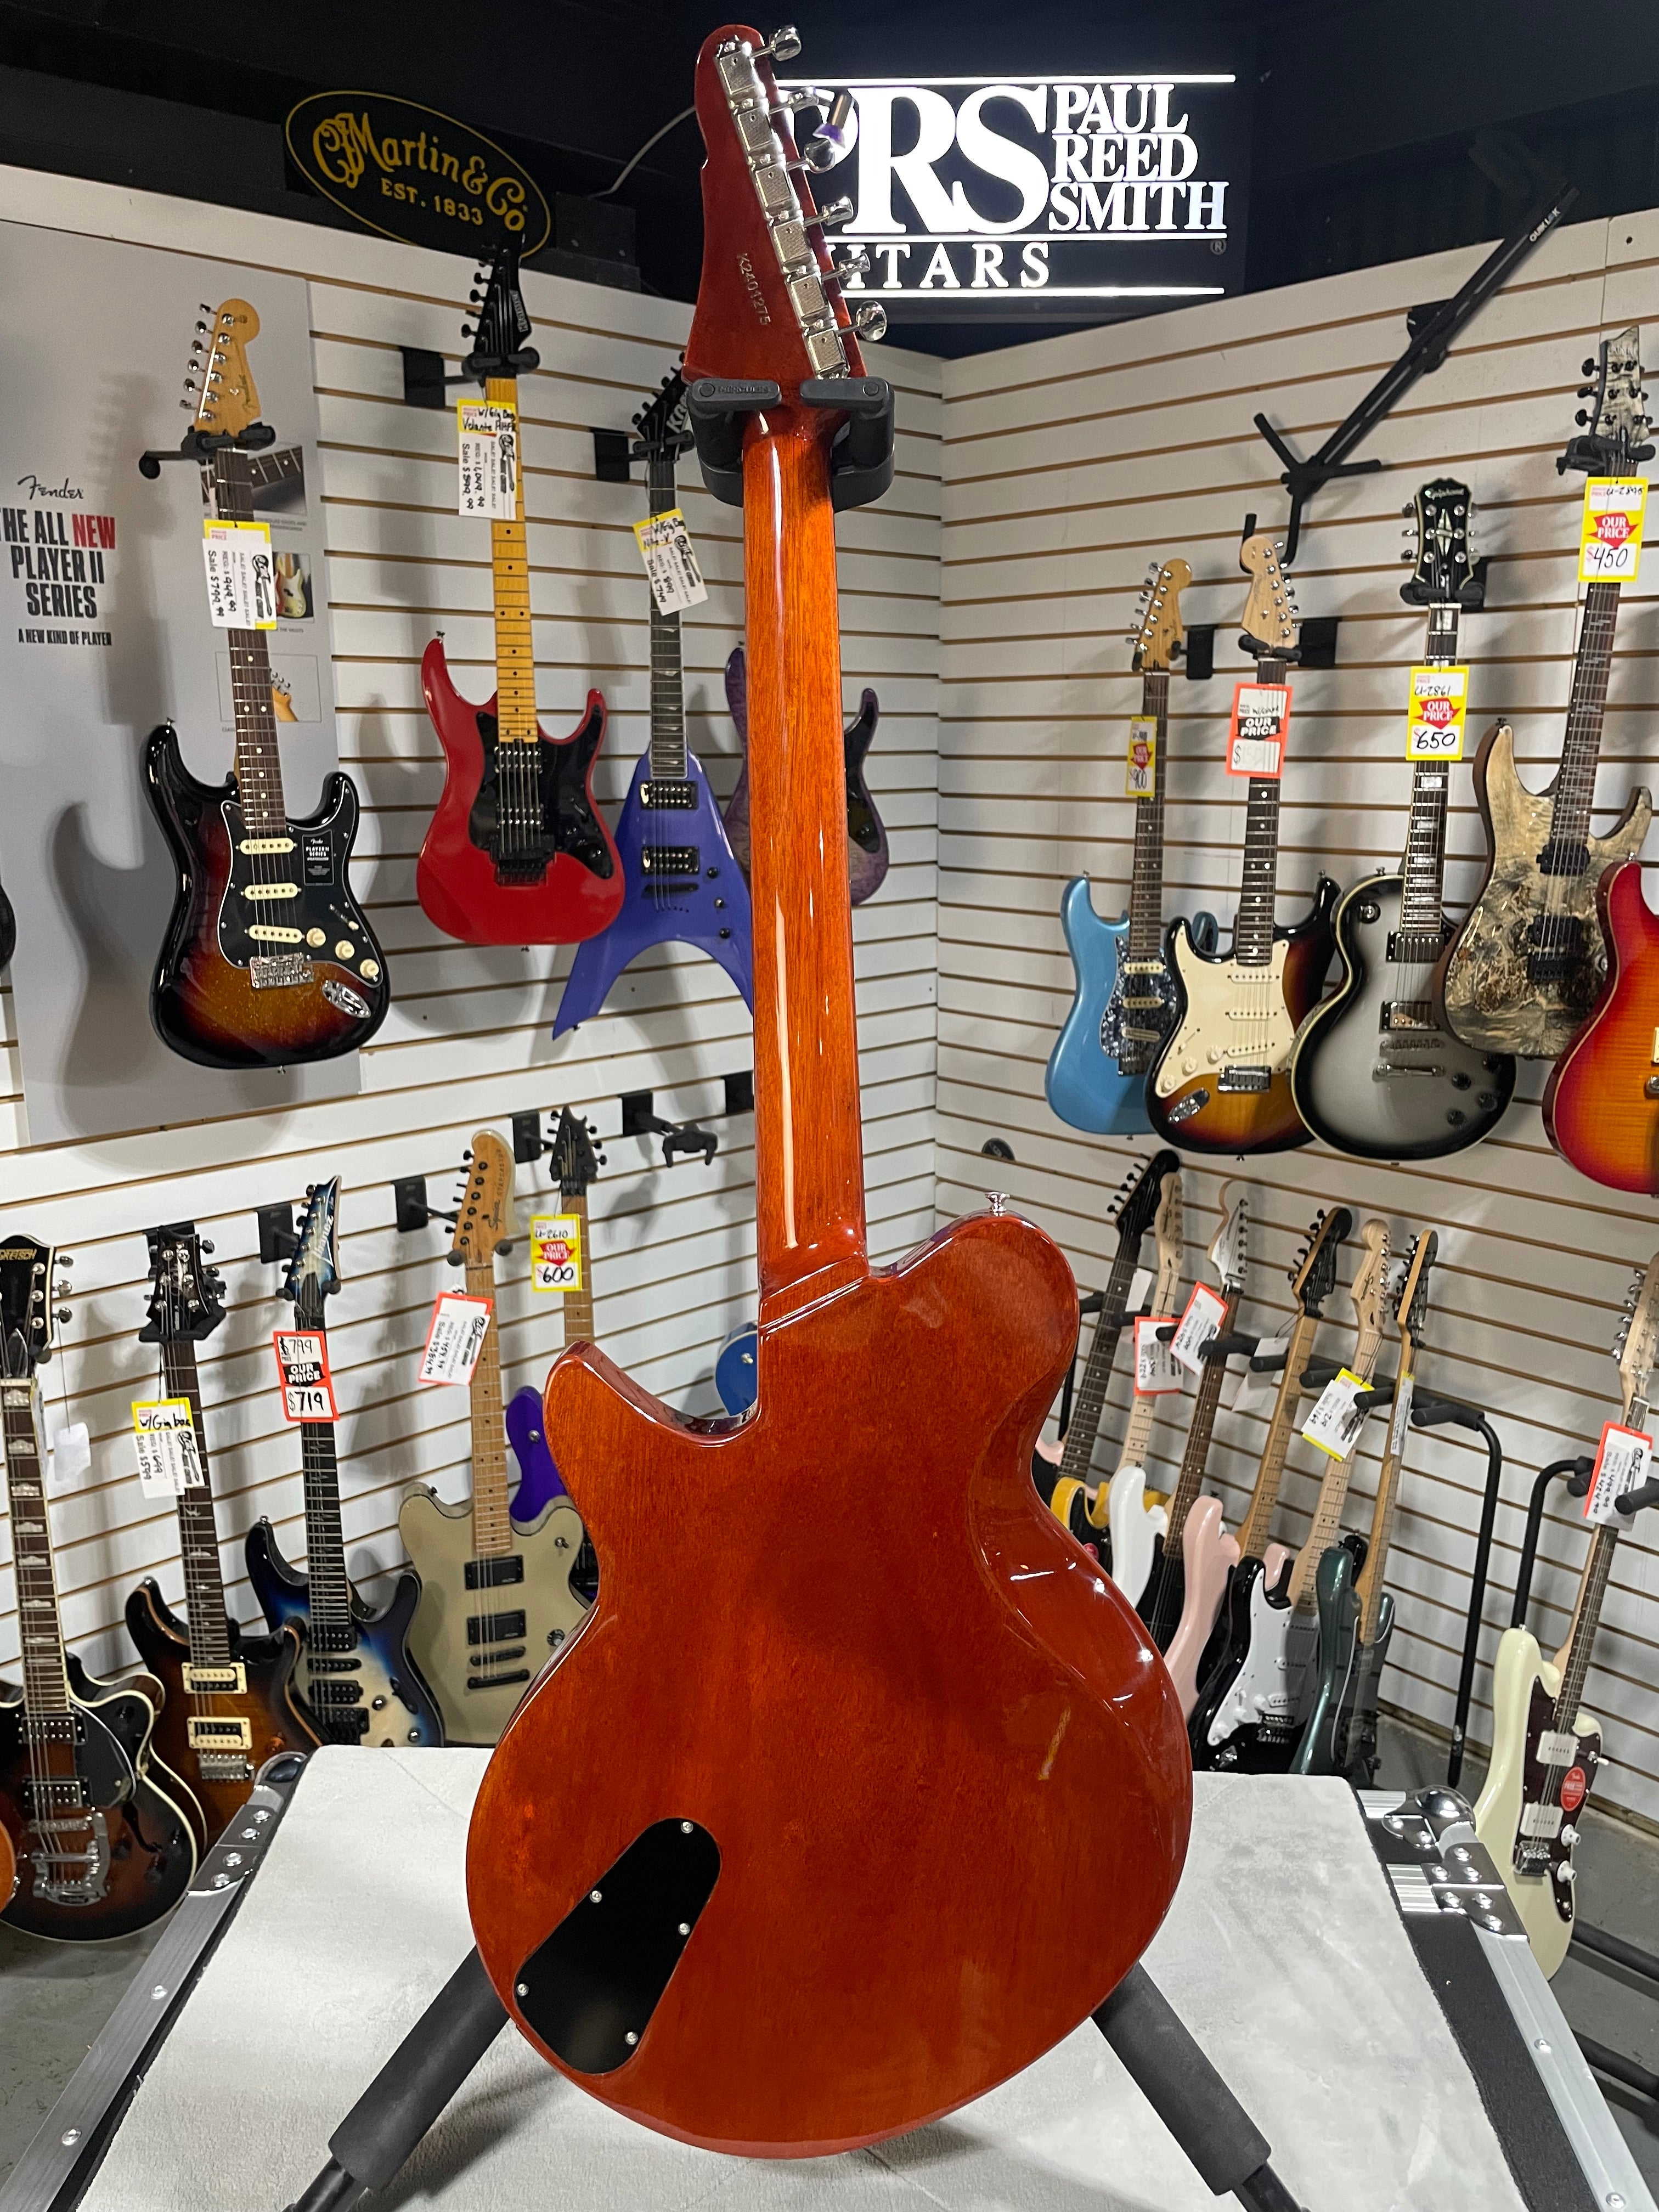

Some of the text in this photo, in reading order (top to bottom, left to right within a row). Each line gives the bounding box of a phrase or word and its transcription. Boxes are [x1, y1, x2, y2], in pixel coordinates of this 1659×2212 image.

[1052, 83, 1188, 134] PAUL
[1051, 133, 1199, 182] REED
[381, 177, 483, 226] EST. 1833
[1048, 181, 1229, 231] SMITH
[18, 475, 84, 500] Fender
[0, 507, 115, 549] HE ALL NEW
[1601, 516, 1627, 528] OUR
[1598, 527, 1630, 539] PRICE
[10, 545, 104, 584] PLAYER II
[207, 550, 218, 572] Sale
[1587, 545, 1628, 570] $450
[646, 558, 658, 578] Sale
[26, 583, 97, 619] SERIES
[19, 629, 112, 646] A NEW KIND OF PLAYER
[1423, 710, 1454, 721] PRICE
[1427, 701, 1451, 712] OUR
[1240, 725, 1277, 737] PRICE
[1245, 718, 1272, 727] OUR
[1413, 727, 1456, 749] $650
[544, 1250, 570, 1260] PRICE
[546, 1243, 566, 1251] OUR
[537, 1265, 574, 1283] $600
[288, 1370, 321, 1384] PRICE
[290, 1363, 313, 1374] OUR
[287, 1391, 324, 1412] $719
